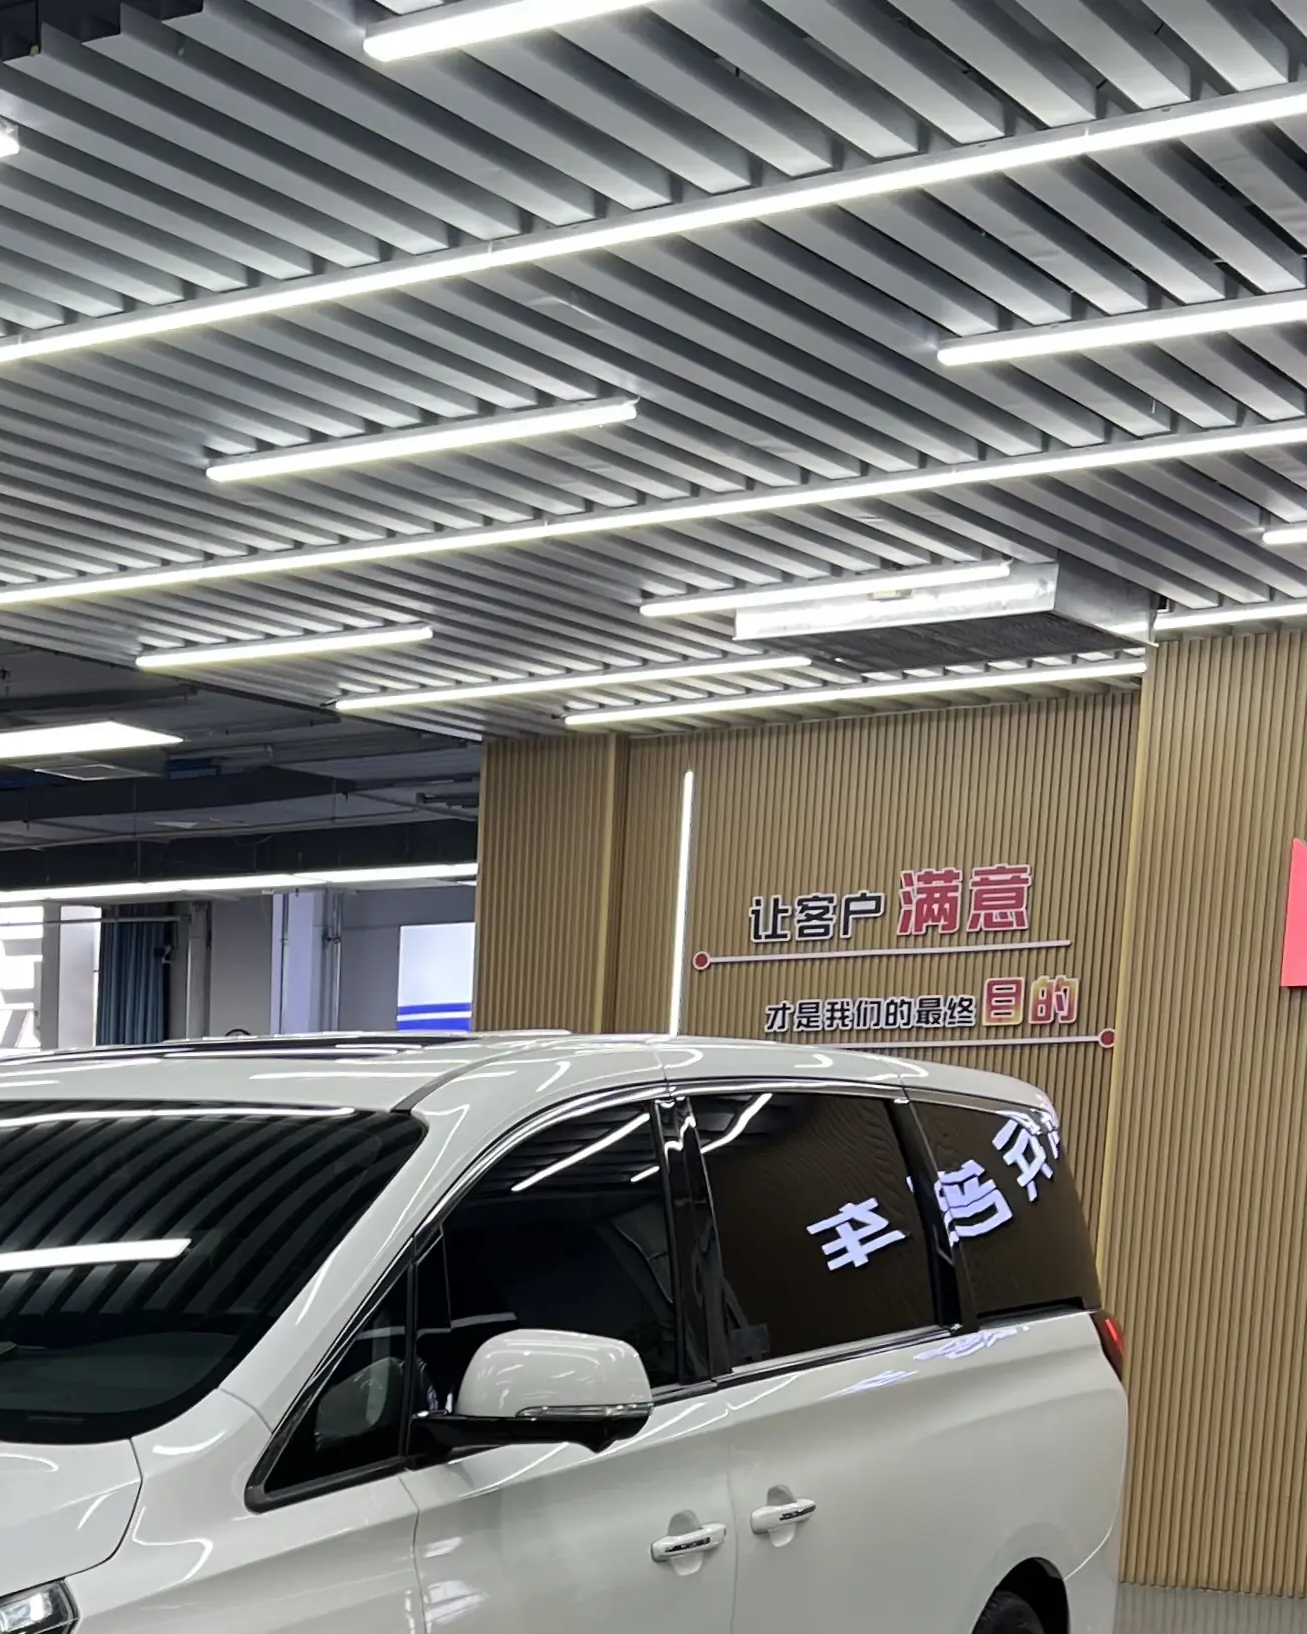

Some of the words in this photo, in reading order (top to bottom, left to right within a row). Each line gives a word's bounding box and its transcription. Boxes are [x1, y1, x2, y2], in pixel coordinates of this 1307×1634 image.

[749, 863, 1033, 943] 让客户满意
[763, 974, 1080, 1033] 才是我们的最终目的
